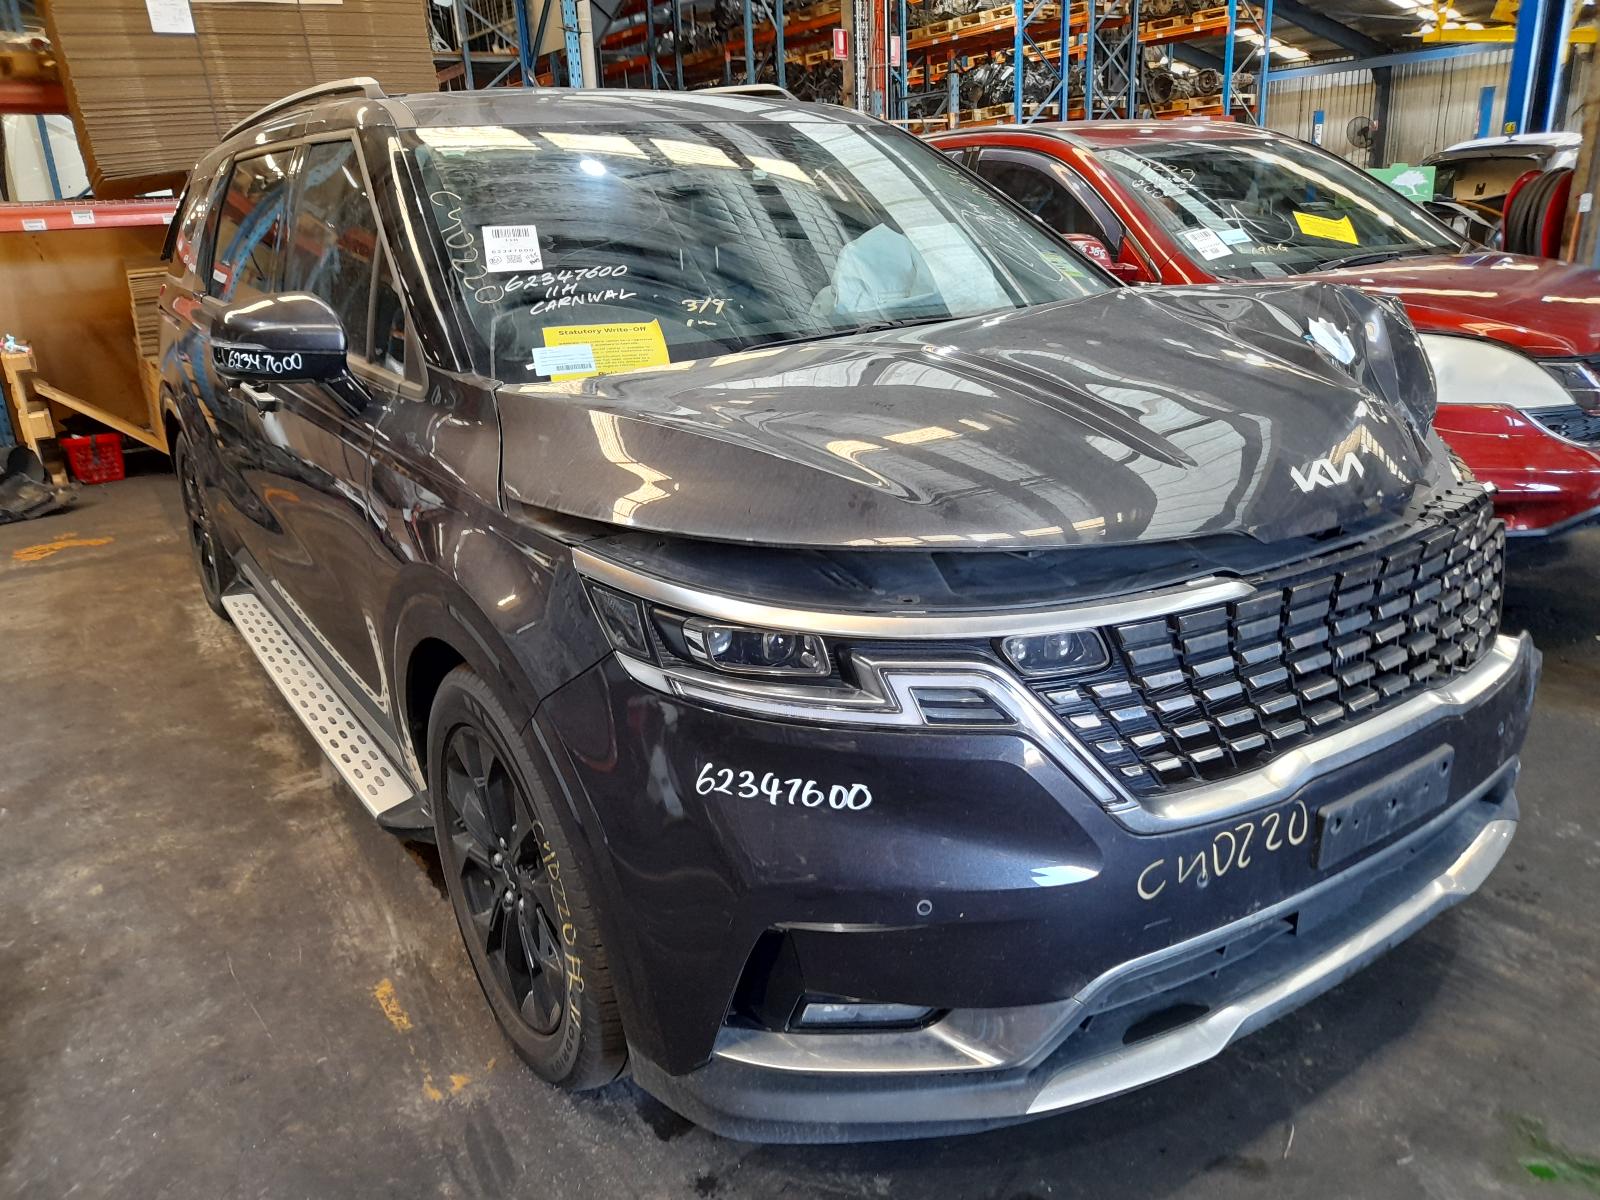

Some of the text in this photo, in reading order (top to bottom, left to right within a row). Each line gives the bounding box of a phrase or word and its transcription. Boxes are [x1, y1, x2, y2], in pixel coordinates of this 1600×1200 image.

[504, 264, 628, 292] 62347600
[558, 325, 647, 336] Statutory Write-Off
[228, 350, 302, 373] 62347600
[1290, 451, 1365, 493] KIA
[695, 762, 872, 811] 62347600
